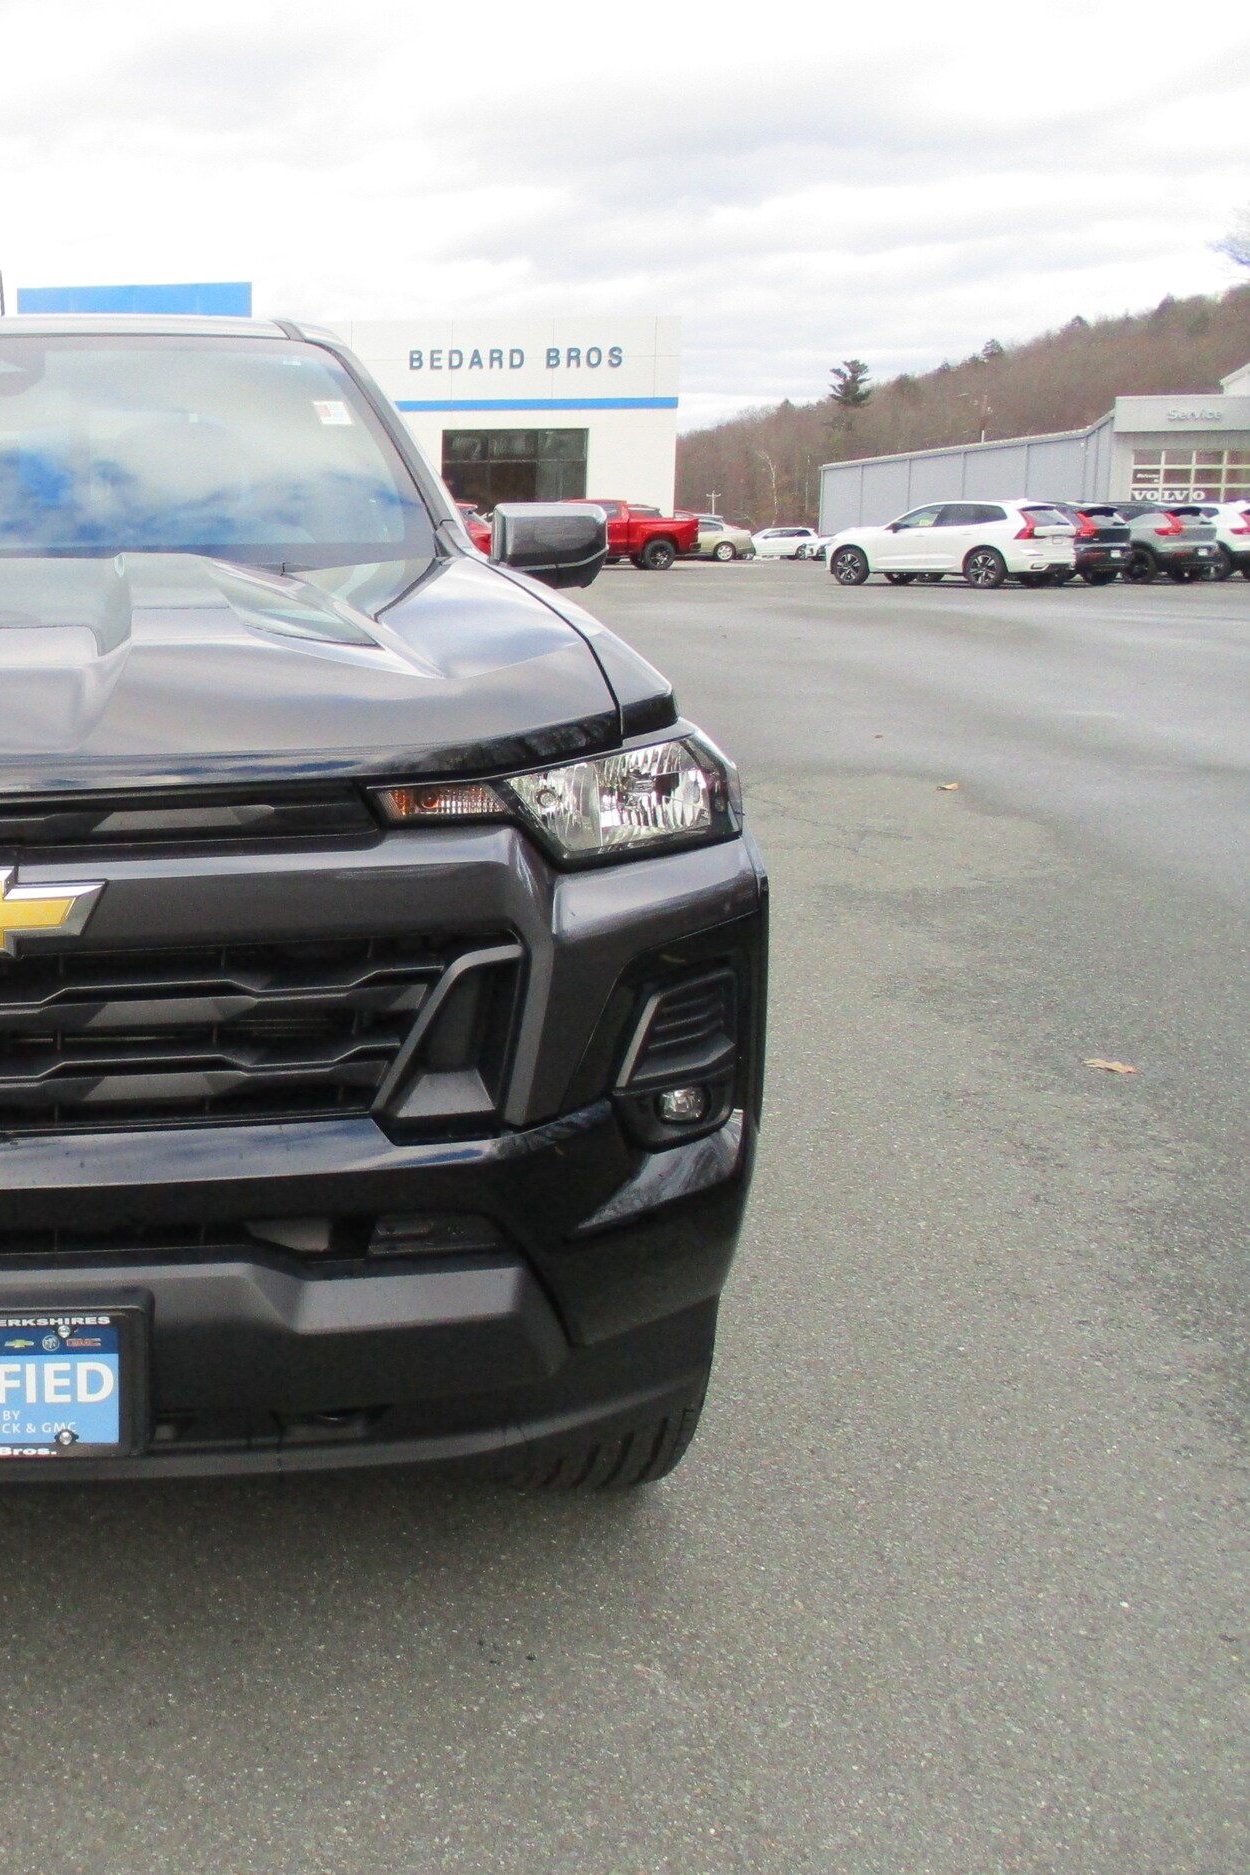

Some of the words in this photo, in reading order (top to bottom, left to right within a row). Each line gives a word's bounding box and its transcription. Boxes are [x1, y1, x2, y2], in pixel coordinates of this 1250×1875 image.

[409, 348, 525, 370] BEDARD
[546, 346, 623, 368] BROS
[1168, 409, 1221, 421] Service
[1132, 490, 1205, 500] VOLVO
[3, 1410, 21, 1421] BY
[26, 1423, 36, 1434] &
[42, 1421, 77, 1433] GMC
